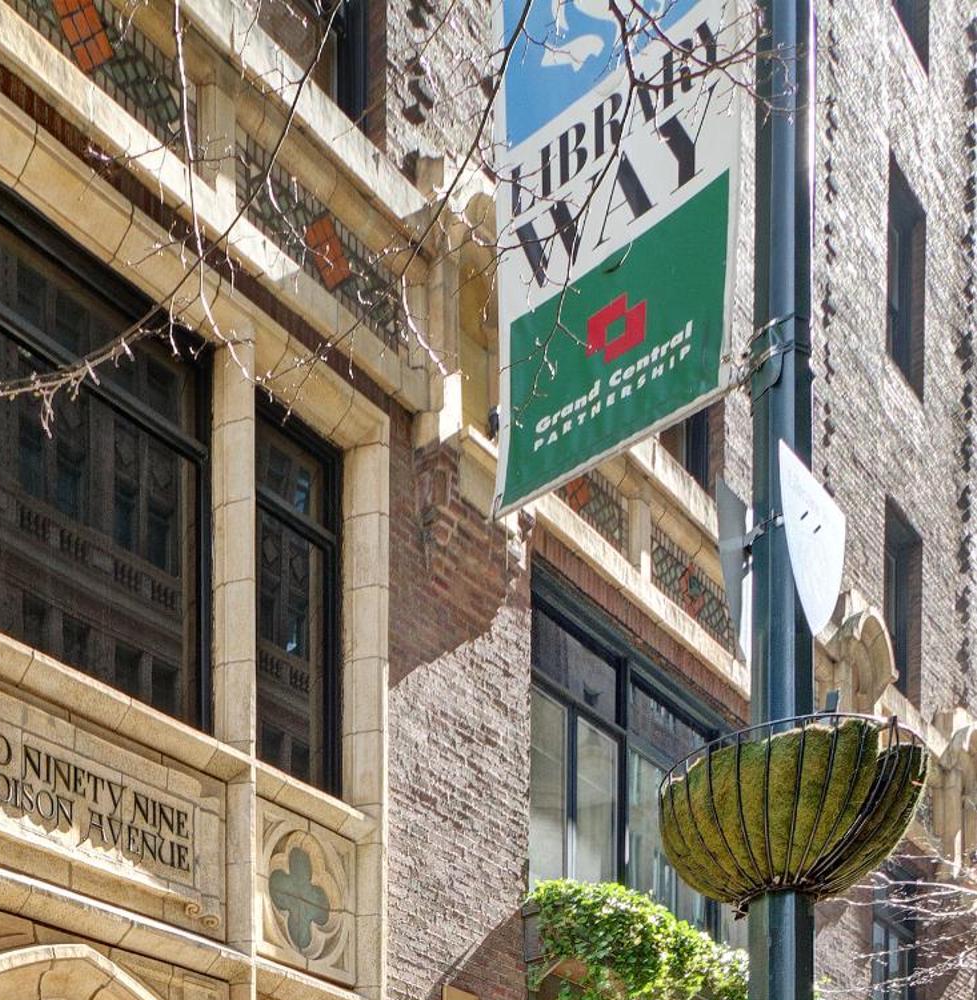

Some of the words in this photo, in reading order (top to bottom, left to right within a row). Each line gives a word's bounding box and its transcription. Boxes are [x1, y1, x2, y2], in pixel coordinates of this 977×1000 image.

[510, 15, 721, 219] LIBRARY
[509, 79, 720, 288] WAY
[534, 344, 691, 452] PARTNERSHIP
[535, 379, 601, 433] Grand
[609, 320, 693, 387] Central
[23, 744, 125, 816] NINETY
[131, 791, 189, 839] NINE
[76, 807, 190, 872] AVENUE
